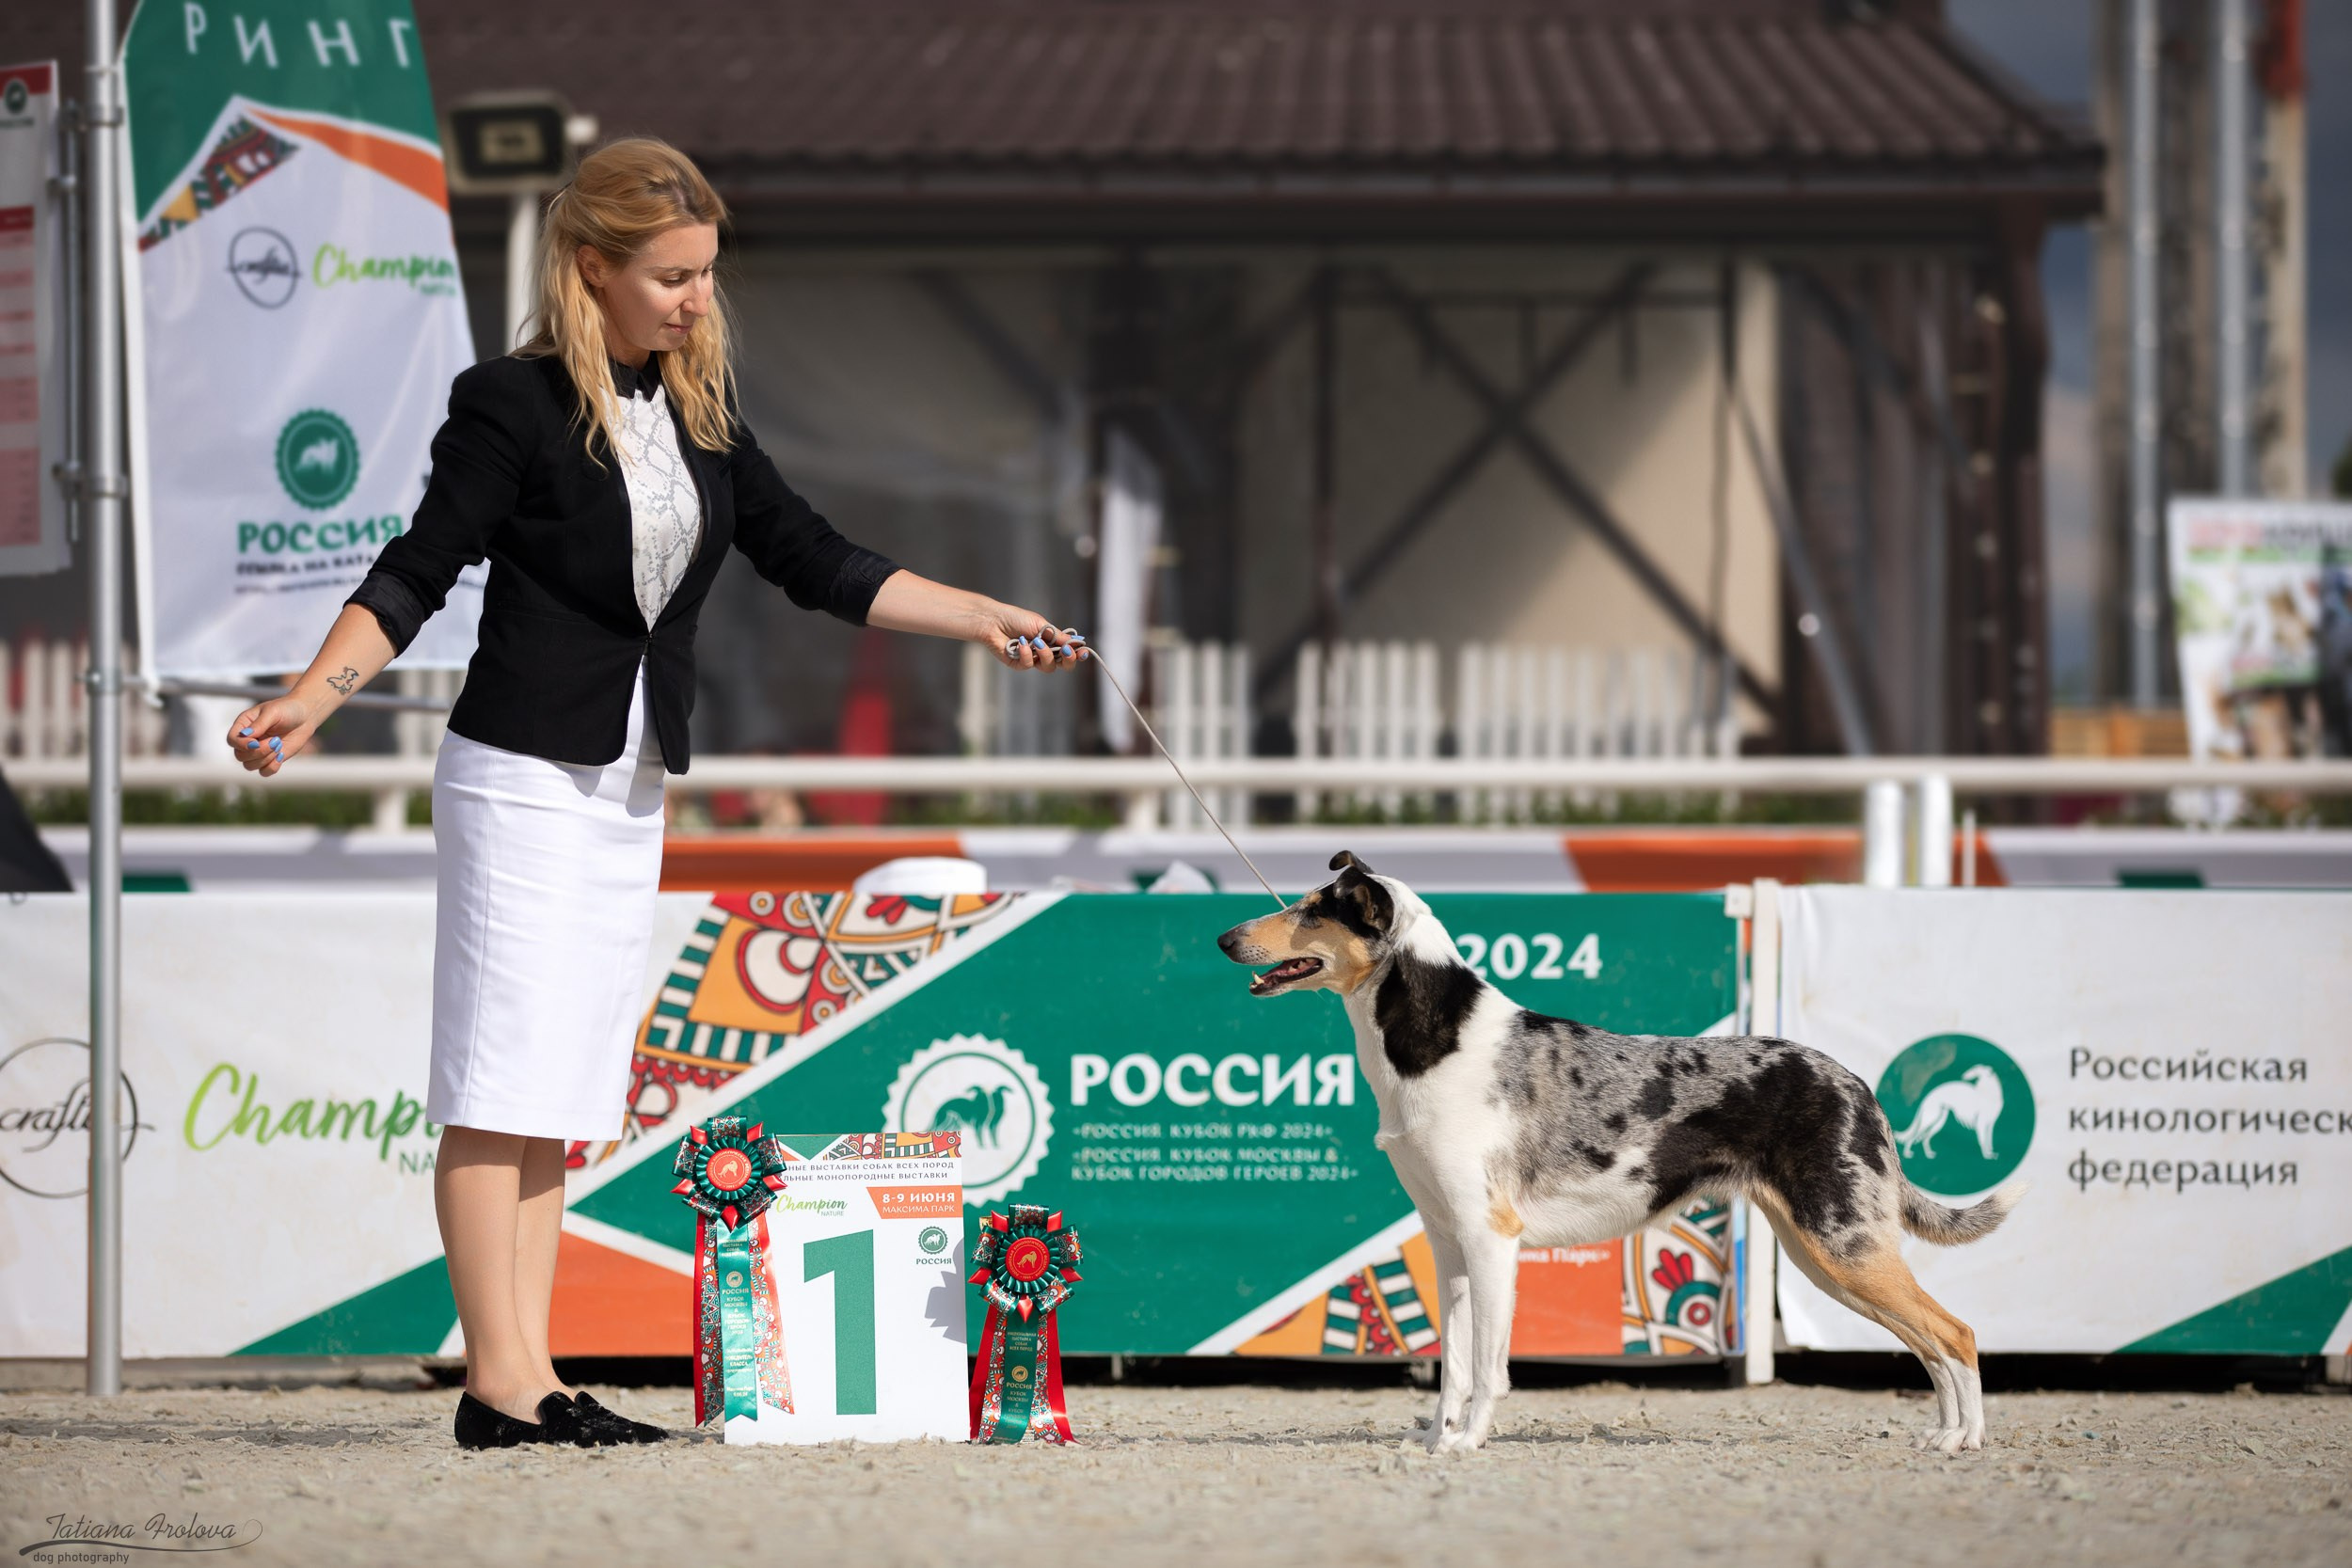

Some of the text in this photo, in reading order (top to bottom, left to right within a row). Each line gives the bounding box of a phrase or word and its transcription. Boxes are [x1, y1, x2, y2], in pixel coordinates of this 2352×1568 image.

[184, 2, 411, 68] РИНГ
[237, 515, 404, 553] РОССИЯ
[1455, 932, 1602, 980] 2024
[1071, 1053, 1355, 1107] РОССИЯ
[2069, 1046, 2308, 1081] Российская
[183, 1062, 444, 1162] Champ
[2069, 1107, 2352, 1133] кинологическ
[1169, 1123, 1232, 1139] КУБОК
[1237, 1123, 1277, 1139] РКФ
[1072, 1165, 1135, 1181] КУБОК
[1138, 1165, 1229, 1182] ГОРОДОВ
[1233, 1164, 1304, 1181] ГЕРОЕВ
[1169, 1147, 1232, 1163] КУБОК
[1237, 1147, 1321, 1164] МОСКВЫ
[1324, 1147, 1339, 1164] &
[2069, 1148, 2298, 1194] федерация
[776, 1194, 848, 1214] Champion
[882, 1192, 955, 1203] 8-9 ИЮНЯ
[803, 1228, 877, 1416] 1
